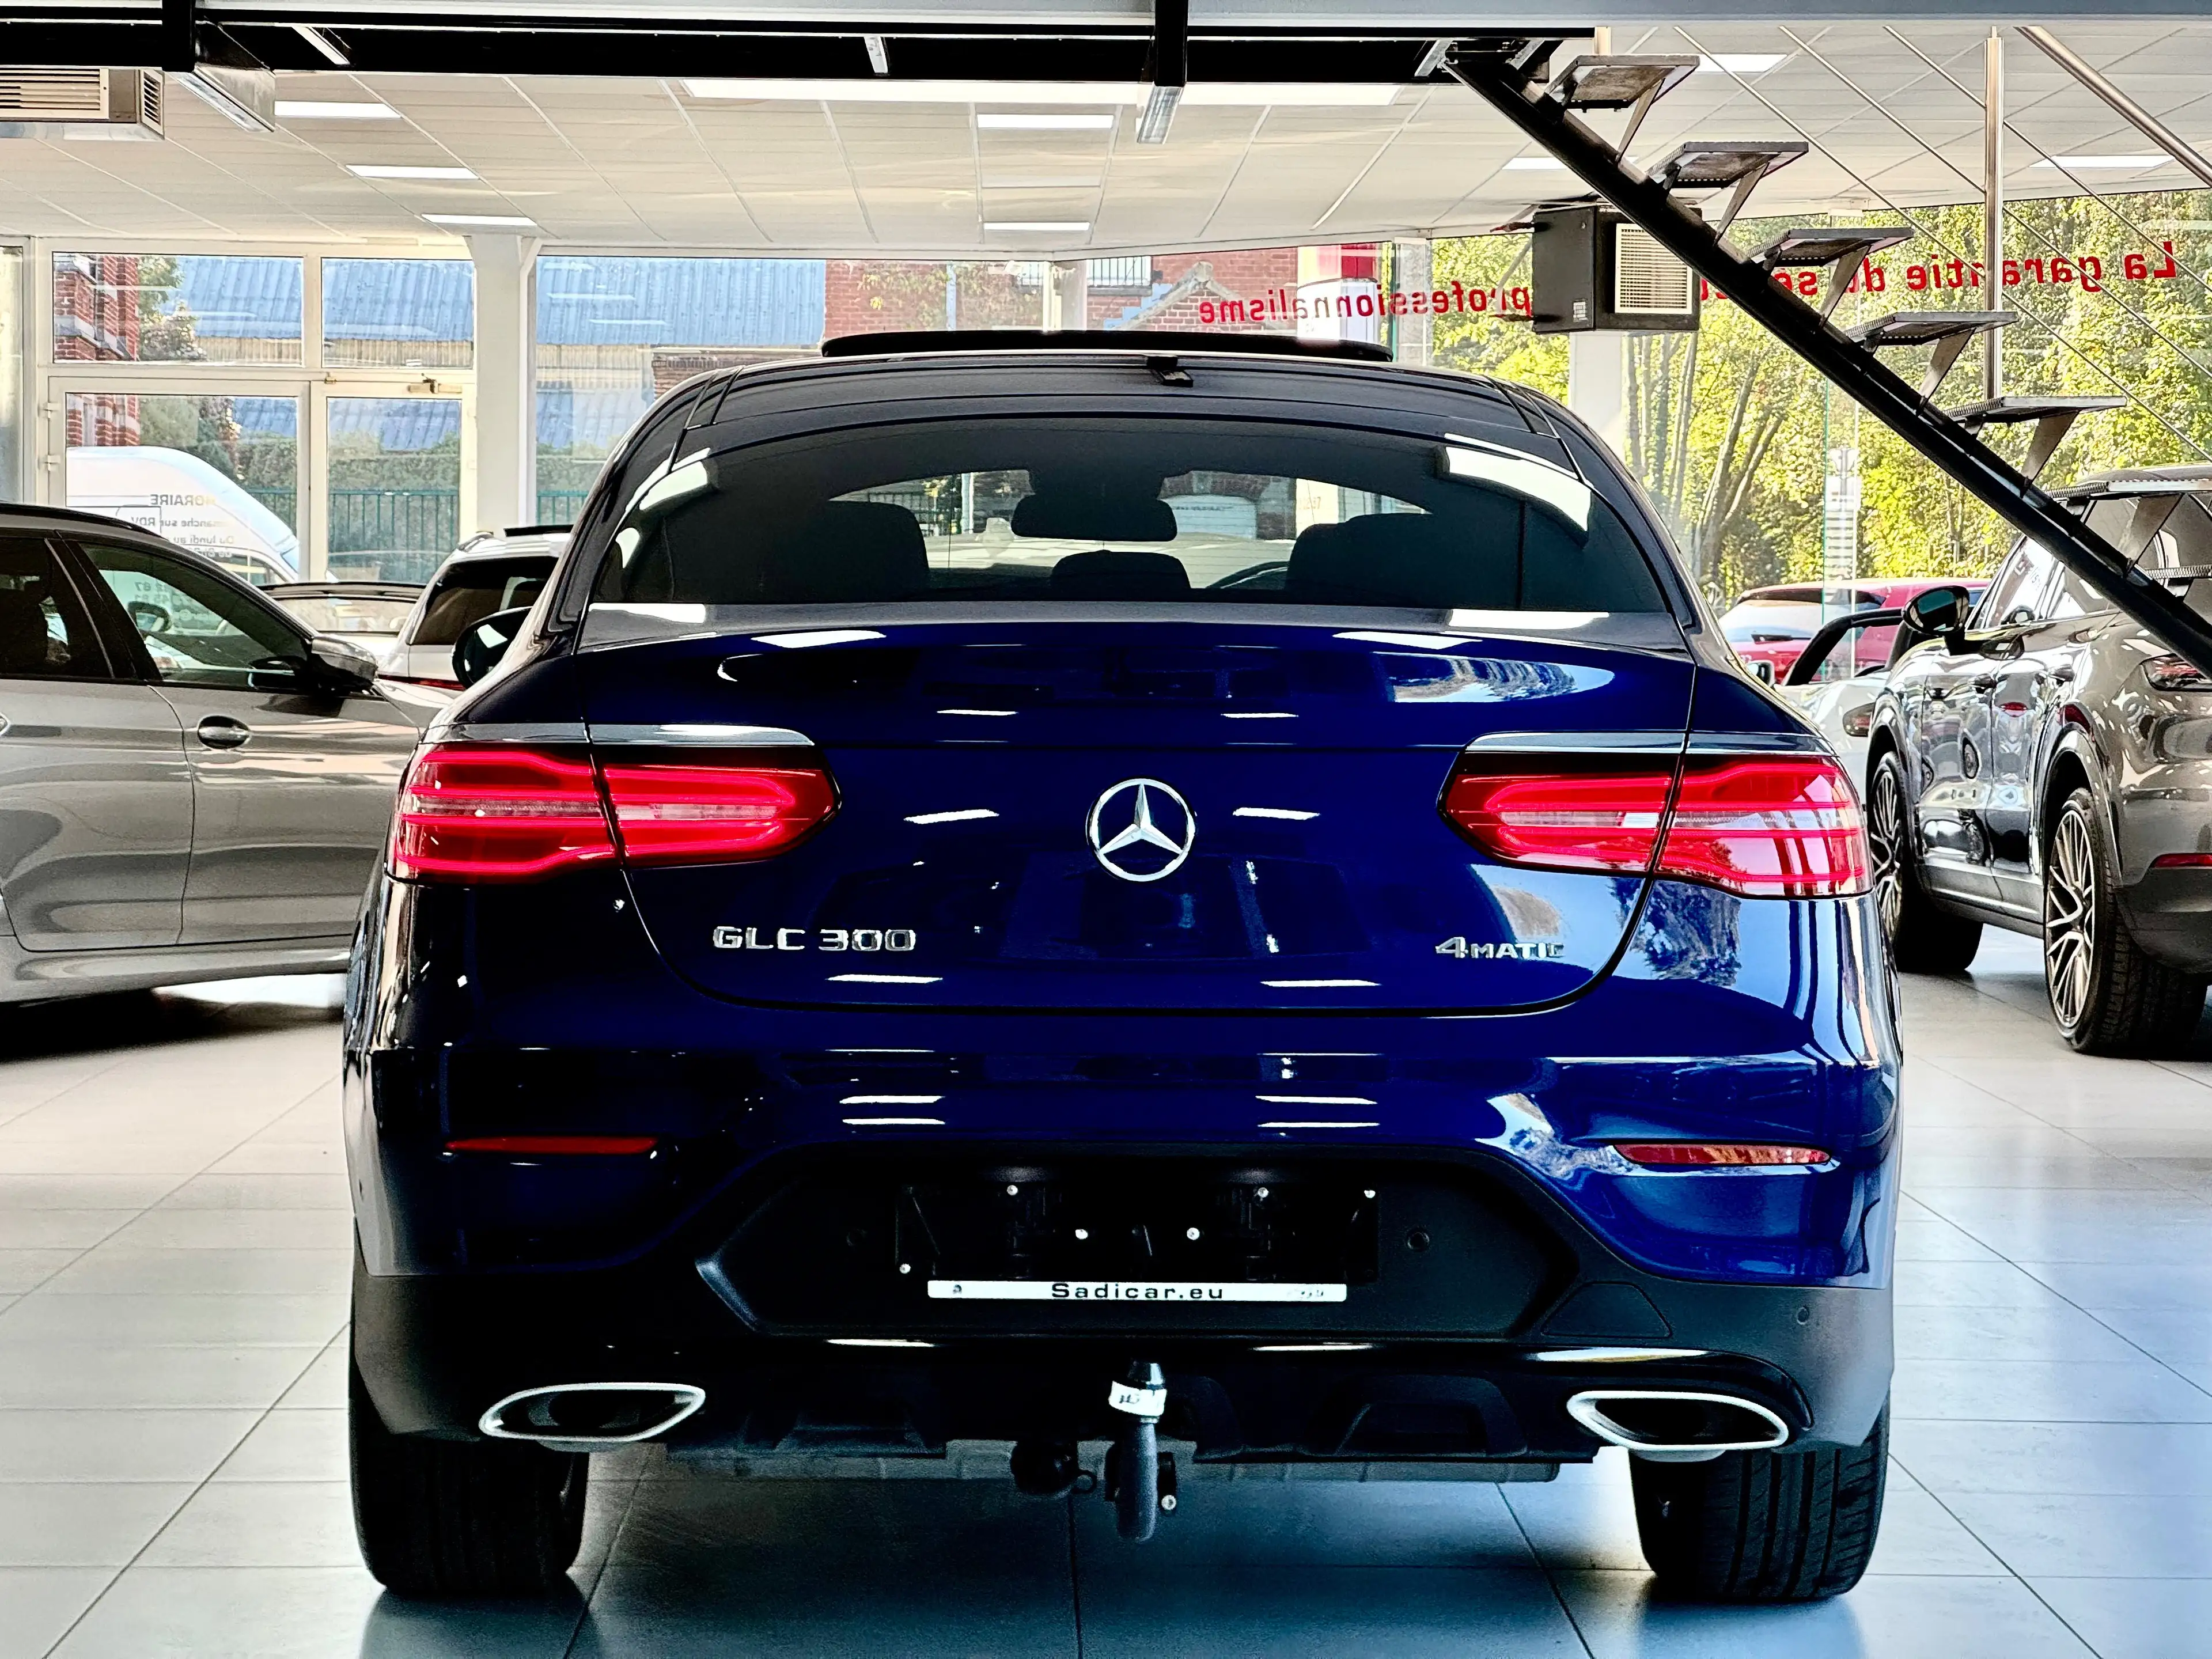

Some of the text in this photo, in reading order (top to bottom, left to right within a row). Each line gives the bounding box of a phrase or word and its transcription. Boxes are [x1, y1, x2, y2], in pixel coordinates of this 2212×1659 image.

[712, 925, 916, 952] GLC 300
[1435, 936, 1565, 959] 4MATIC
[1051, 1282, 1224, 1300] Sadicar.eu
